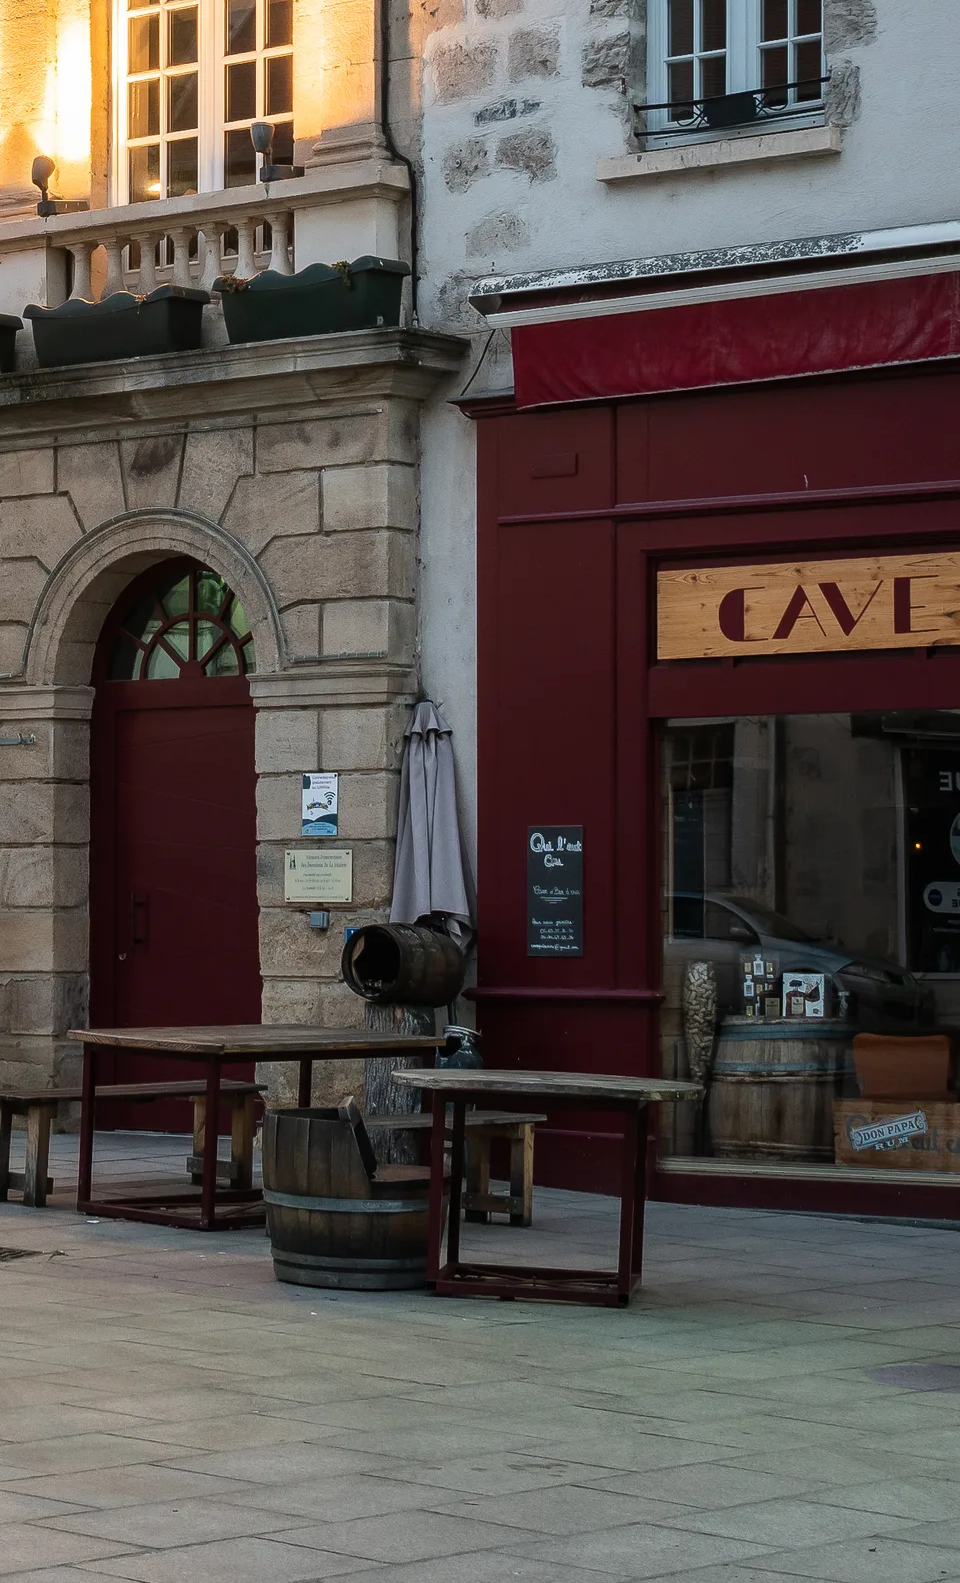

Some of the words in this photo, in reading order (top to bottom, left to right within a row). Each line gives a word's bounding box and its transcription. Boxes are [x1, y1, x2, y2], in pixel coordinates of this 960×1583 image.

[718, 574, 941, 643] CAVE
[863, 1128, 885, 1142] DON
[888, 1120, 914, 1135] PAPA
[874, 1136, 909, 1150] RUM
